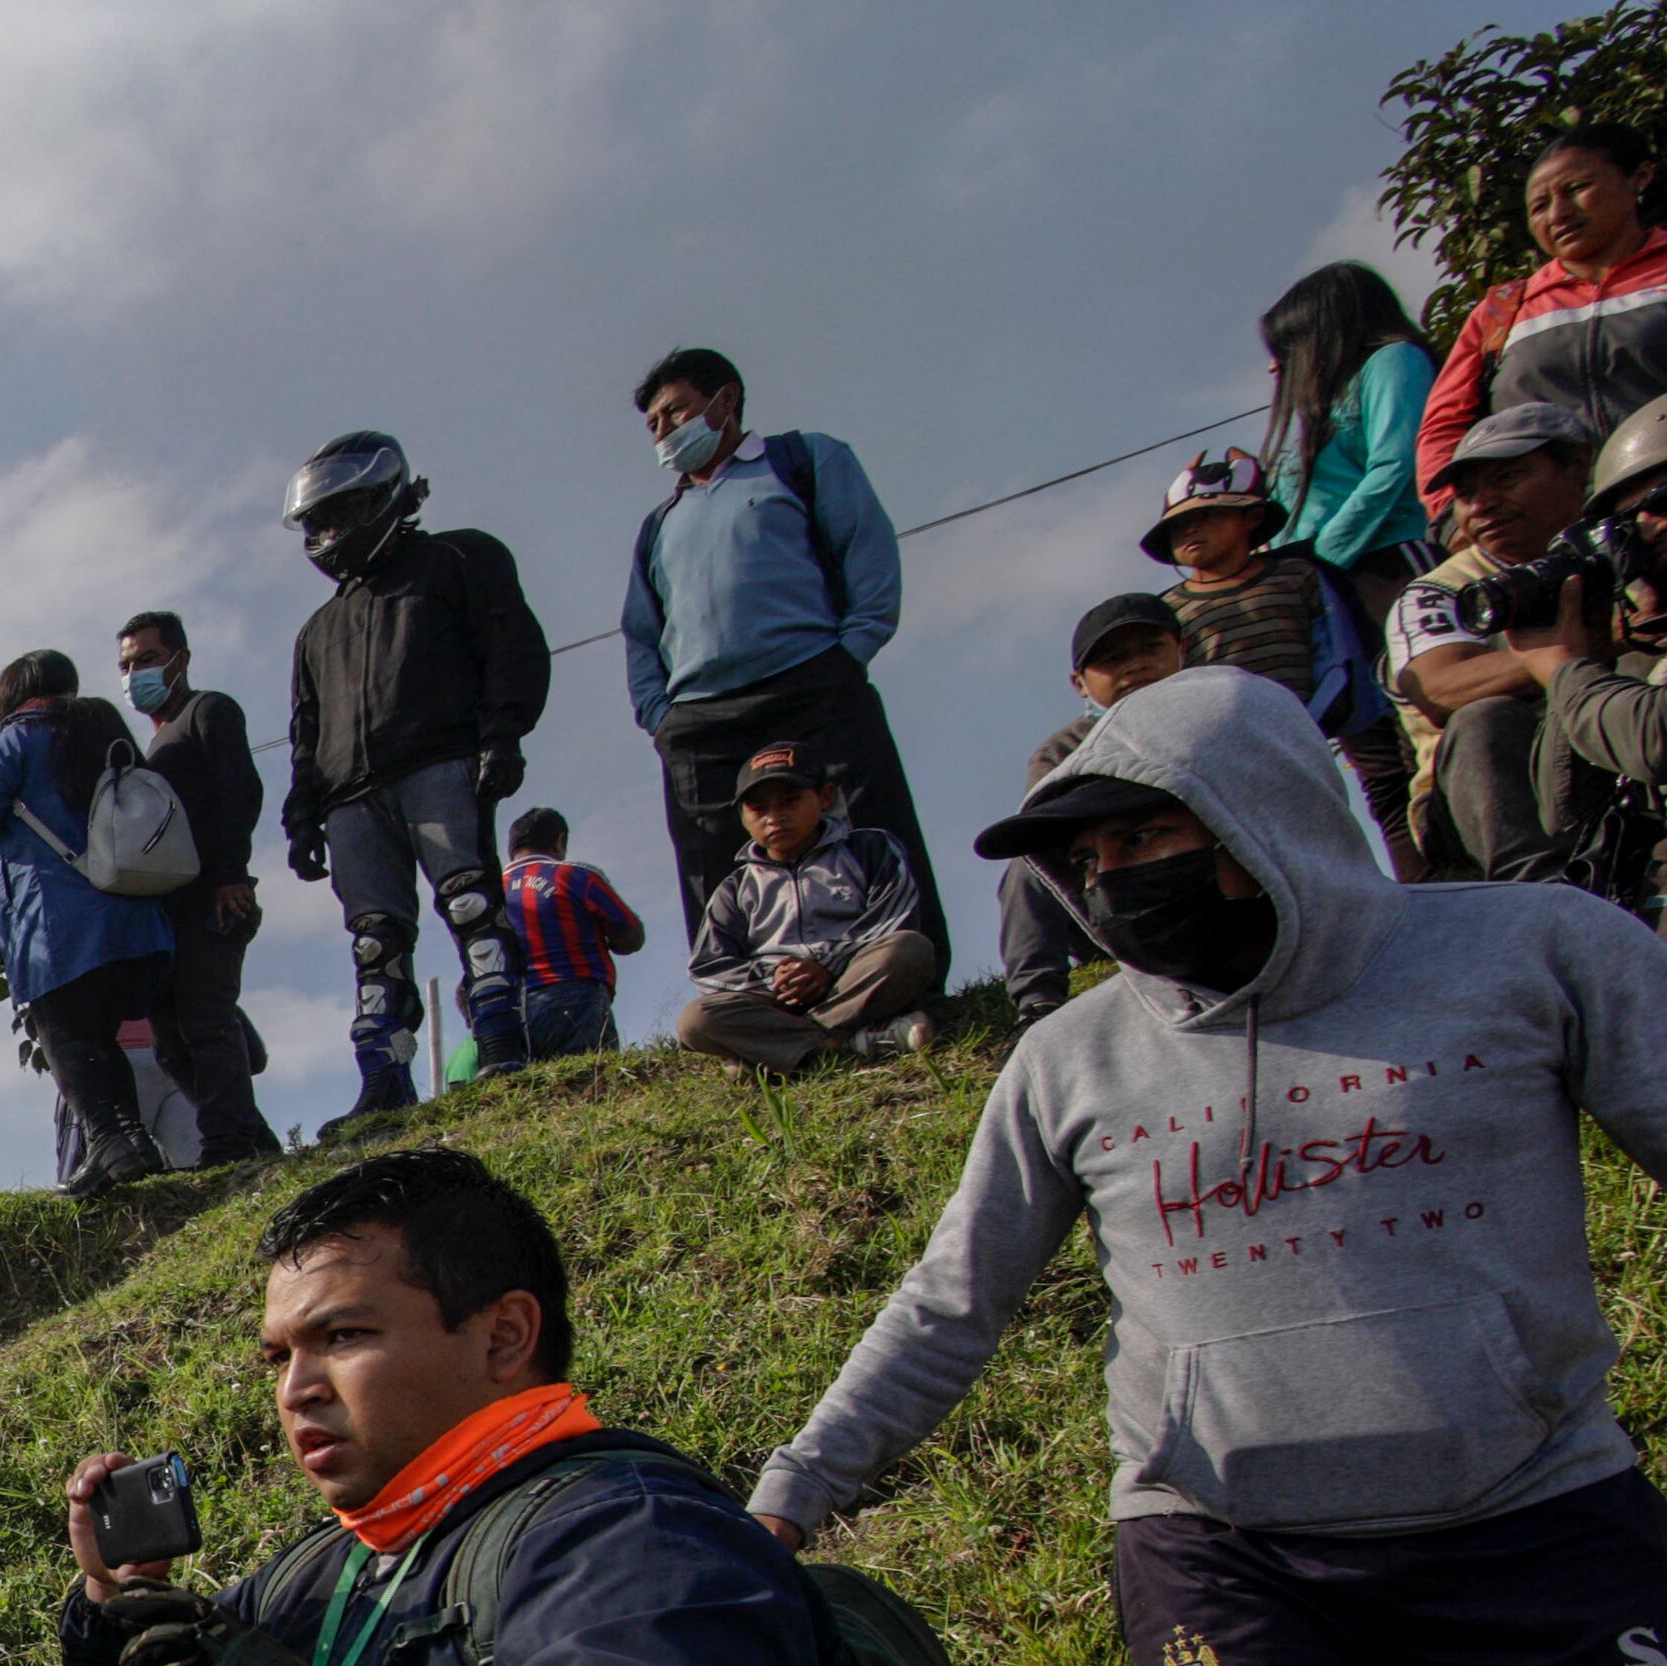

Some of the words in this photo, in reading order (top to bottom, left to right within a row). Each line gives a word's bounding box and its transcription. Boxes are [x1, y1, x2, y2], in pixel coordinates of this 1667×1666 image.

[1100, 1053, 1486, 1152] CALIORNIA
[1152, 1228, 1346, 1278] TWENTY
[1380, 1201, 1485, 1237] TWO
